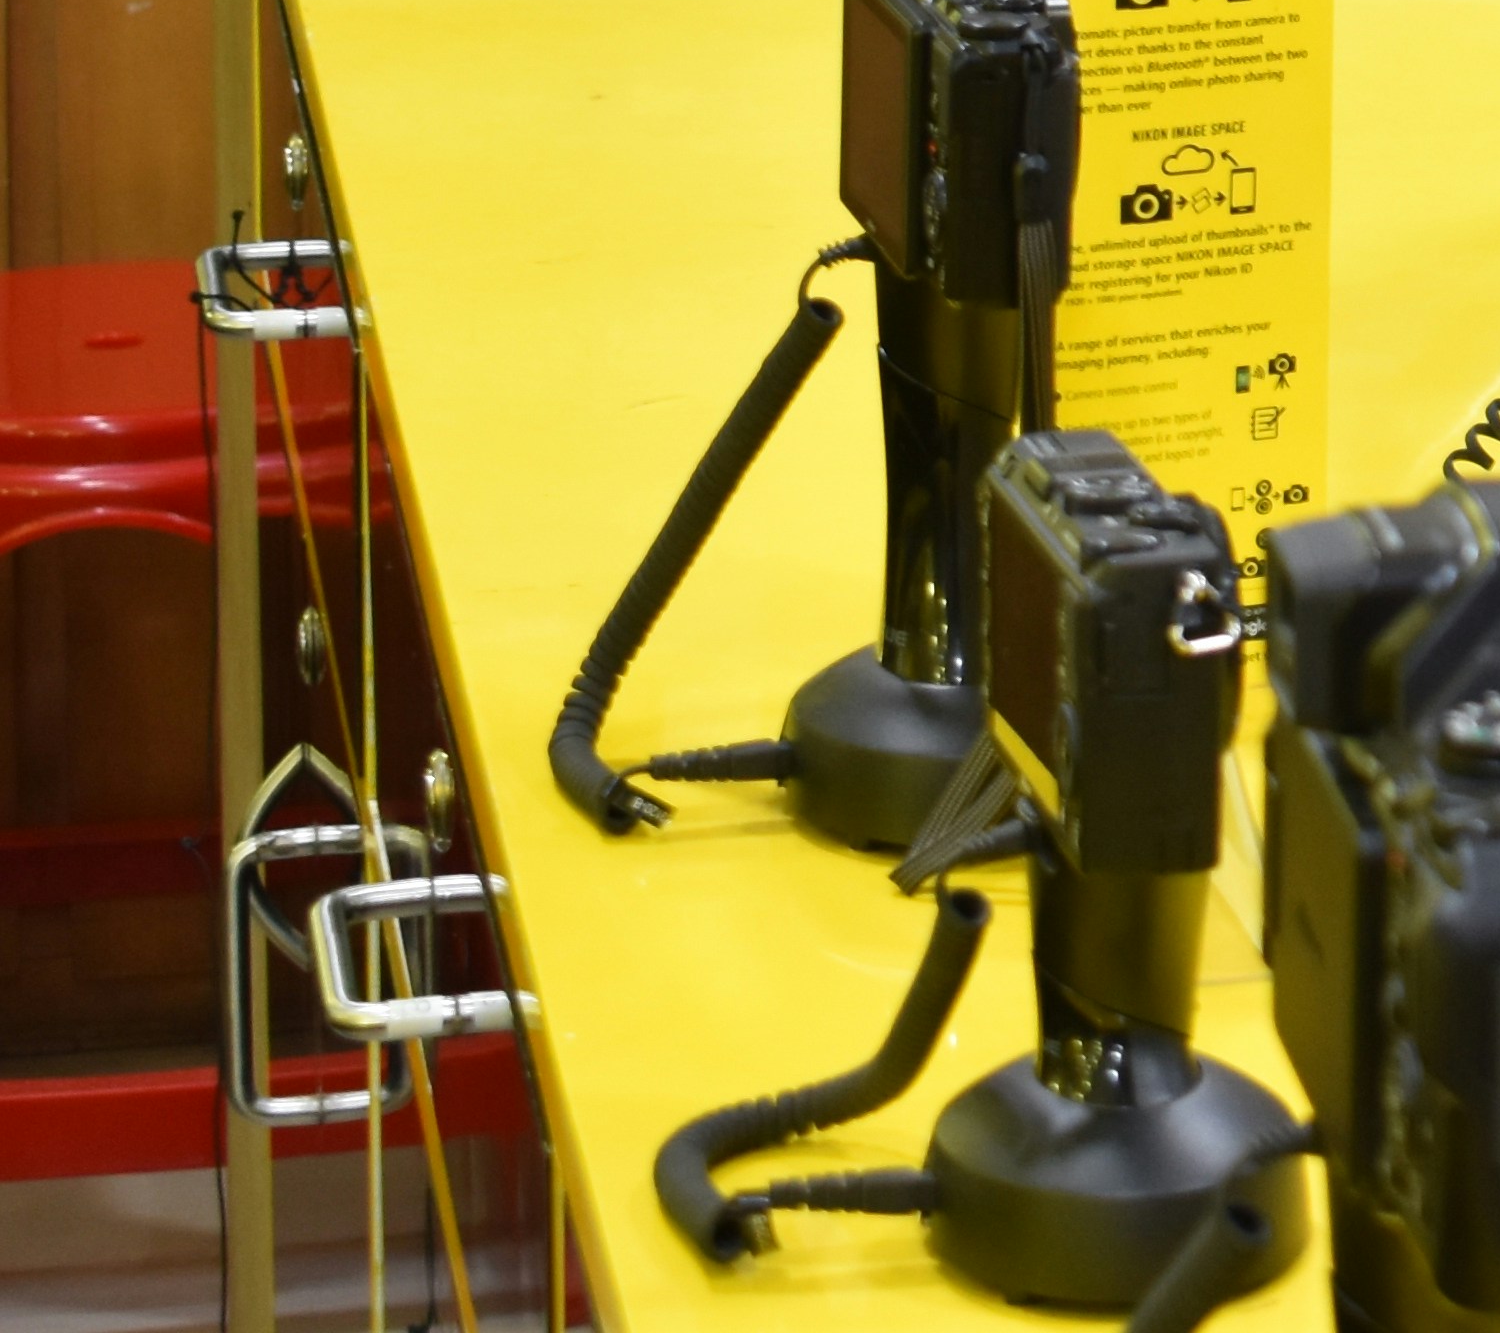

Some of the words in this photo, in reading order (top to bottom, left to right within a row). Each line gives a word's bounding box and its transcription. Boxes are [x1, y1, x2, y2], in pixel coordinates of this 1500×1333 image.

[1123, 24, 1164, 40] picture
[1167, 21, 1211, 34] transfer
[1215, 17, 1242, 29] from
[1245, 15, 1286, 28] camera
[1288, 12, 1300, 23] to
[1097, 45, 1134, 58] device
[1138, 42, 1175, 55] thanks
[1179, 41, 1190, 52] to
[1194, 39, 1212, 50] the
[1216, 35, 1264, 49] constant
[1127, 63, 1144, 74] via
[1214, 55, 1263, 68] between
[1266, 50, 1283, 62] the
[1287, 48, 1308, 60] two
[1124, 81, 1166, 95] making
[1169, 77, 1205, 90] online
[1207, 73, 1241, 88] photo
[1244, 70, 1285, 84] sharing
[1098, 102, 1123, 113] than
[1127, 101, 1152, 111] ever
[1131, 129, 1168, 143] NIKON
[1171, 124, 1206, 139] IMAGE
[1211, 121, 1246, 135] SPACE
[1090, 239, 1145, 253] unlimited
[1150, 234, 1188, 249] upload
[1191, 231, 1203, 242] of
[1279, 224, 1291, 234] to
[1294, 220, 1312, 232] the
[1093, 256, 1143, 272] storage
[1141, 254, 1172, 268] space
[1176, 250, 1214, 262] NIKON
[1217, 245, 1256, 258] IMAGE
[1260, 241, 1295, 253] SPACE
[1090, 274, 1152, 291] registering
[1155, 270, 1171, 283] for
[1176, 269, 1201, 283] your
[1204, 264, 1238, 278] Nikon
[1240, 263, 1253, 273] ID
[1069, 340, 1101, 353] range
[1106, 336, 1119, 347] of
[1122, 332, 1166, 346] services
[1170, 329, 1193, 341] that
[1197, 324, 1243, 338] enriches
[1246, 321, 1271, 335] your
[1065, 387, 1104, 401] Camera
